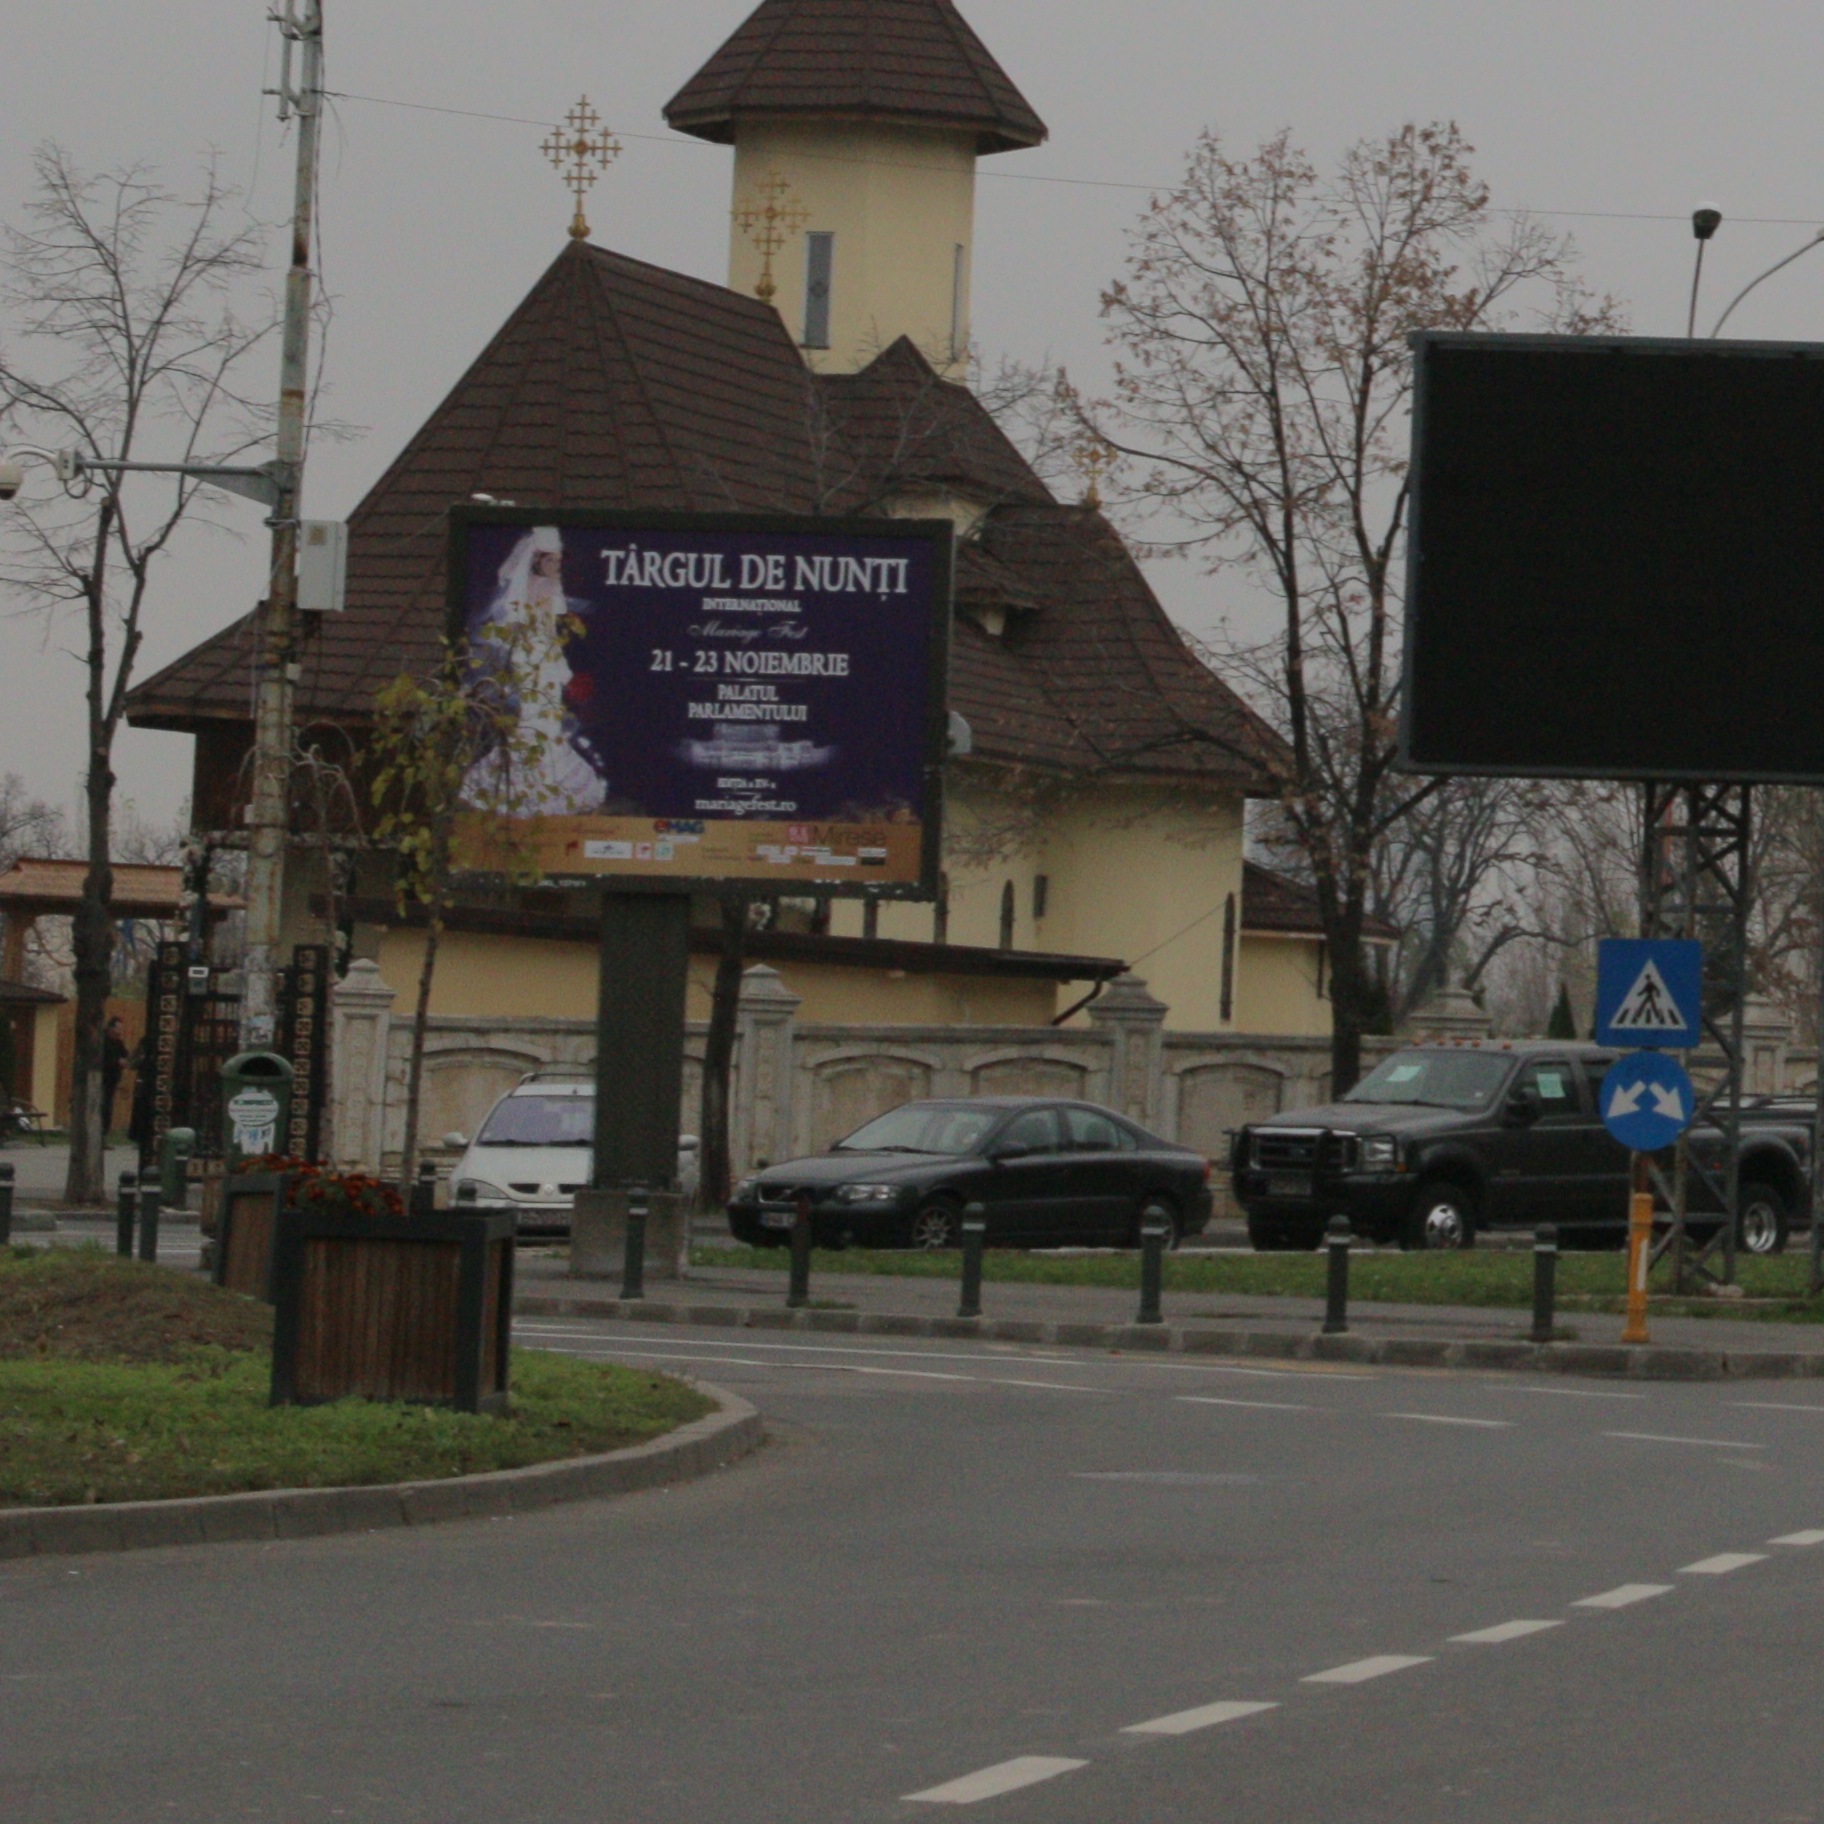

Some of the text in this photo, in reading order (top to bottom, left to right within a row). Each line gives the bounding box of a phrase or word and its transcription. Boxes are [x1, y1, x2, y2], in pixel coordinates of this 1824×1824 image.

[600, 543, 909, 602] TÂRGUL DE NUNȚI
[701, 597, 802, 615] INTERNAȚIONAL
[650, 649, 673, 672] 21
[693, 651, 718, 673] 23
[724, 651, 850, 676] NOIEMBRIE
[717, 684, 779, 701] PALATUL
[688, 702, 808, 721] PARLAMENTULUI
[695, 794, 797, 815] mariagefest.ro
